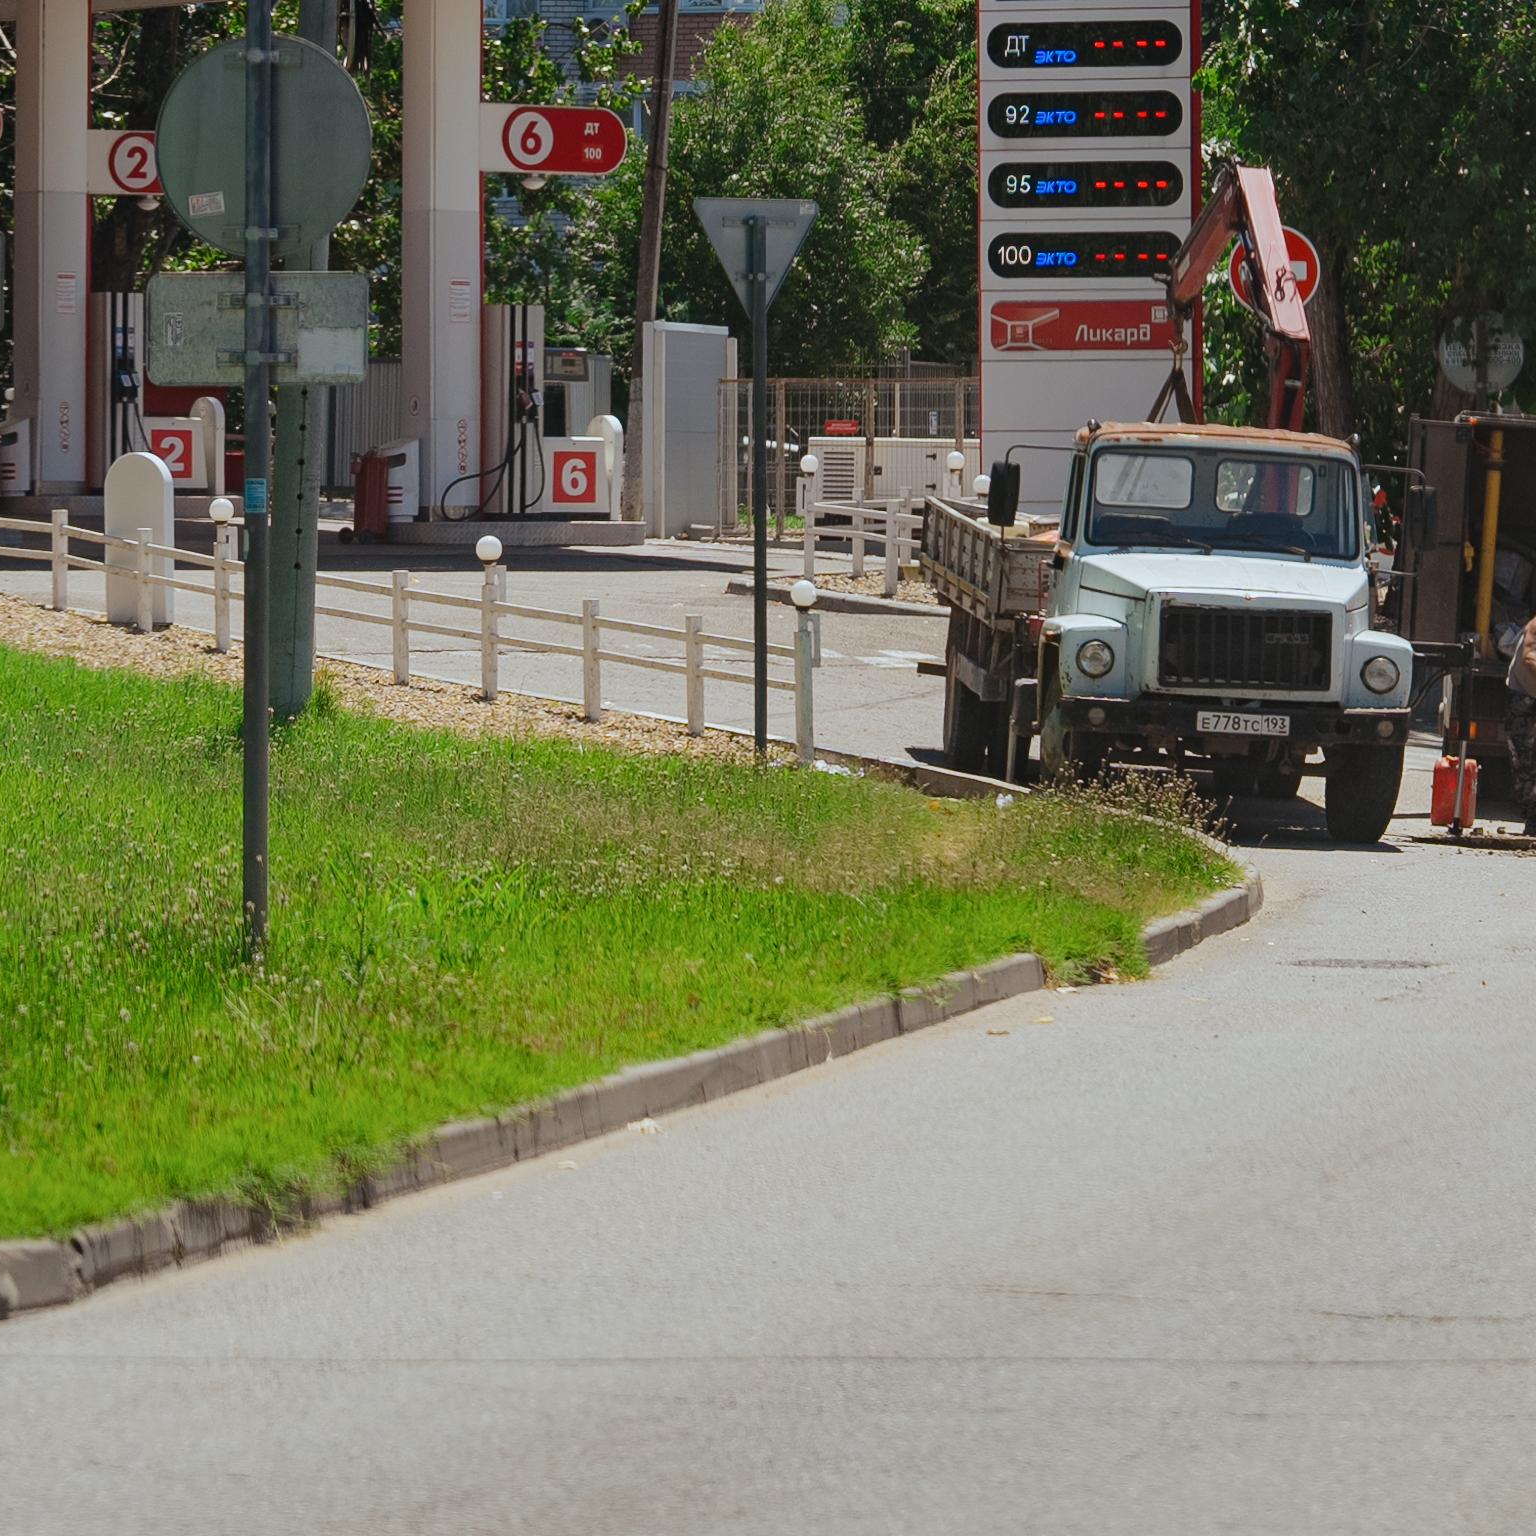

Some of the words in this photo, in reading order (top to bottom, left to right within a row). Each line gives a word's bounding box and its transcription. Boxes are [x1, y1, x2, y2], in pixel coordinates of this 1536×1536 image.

[1004, 35, 1029, 58] ДТ
[1034, 50, 1077, 64] ЭКТО
[1005, 105, 1030, 125] 92
[1035, 111, 1078, 125] ЭКТО
[521, 121, 542, 156] 6
[584, 122, 600, 136] ДТ
[126, 146, 148, 179] 2
[584, 147, 602, 159] 100
[1006, 174, 1032, 194] 95
[1035, 180, 1078, 194] ЭКТО
[997, 245, 1032, 265] 100
[1035, 252, 1078, 267] ЭКТО
[160, 436, 185, 471] 2
[561, 458, 588, 496] 6
